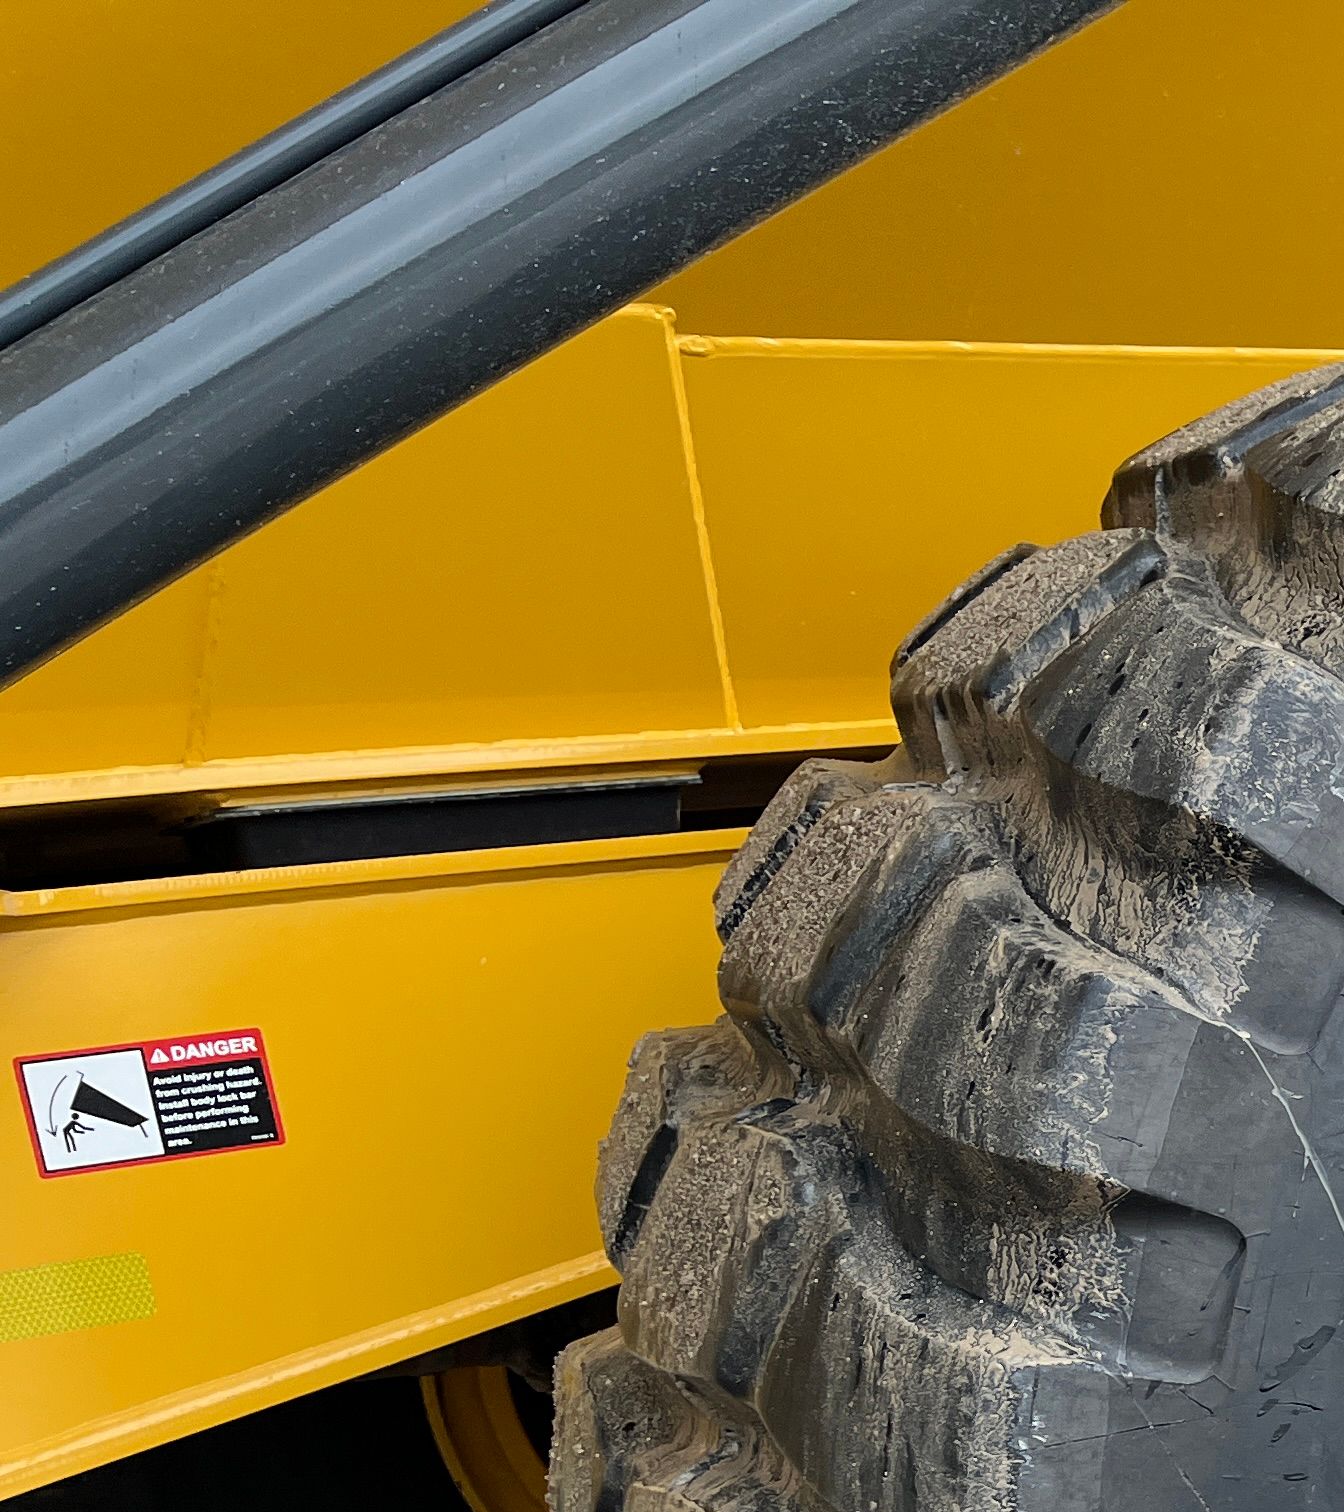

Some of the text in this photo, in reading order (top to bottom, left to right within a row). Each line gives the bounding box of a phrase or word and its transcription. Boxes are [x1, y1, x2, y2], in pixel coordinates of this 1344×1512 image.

[170, 1036, 258, 1061] DANGER
[153, 1065, 254, 1086] Avoid injury or death
[155, 1077, 262, 1098] from crushing hazard.
[158, 1091, 256, 1110] Install body lock bar
[161, 1104, 250, 1123] before performing
[164, 1115, 259, 1135] maintenance in this
